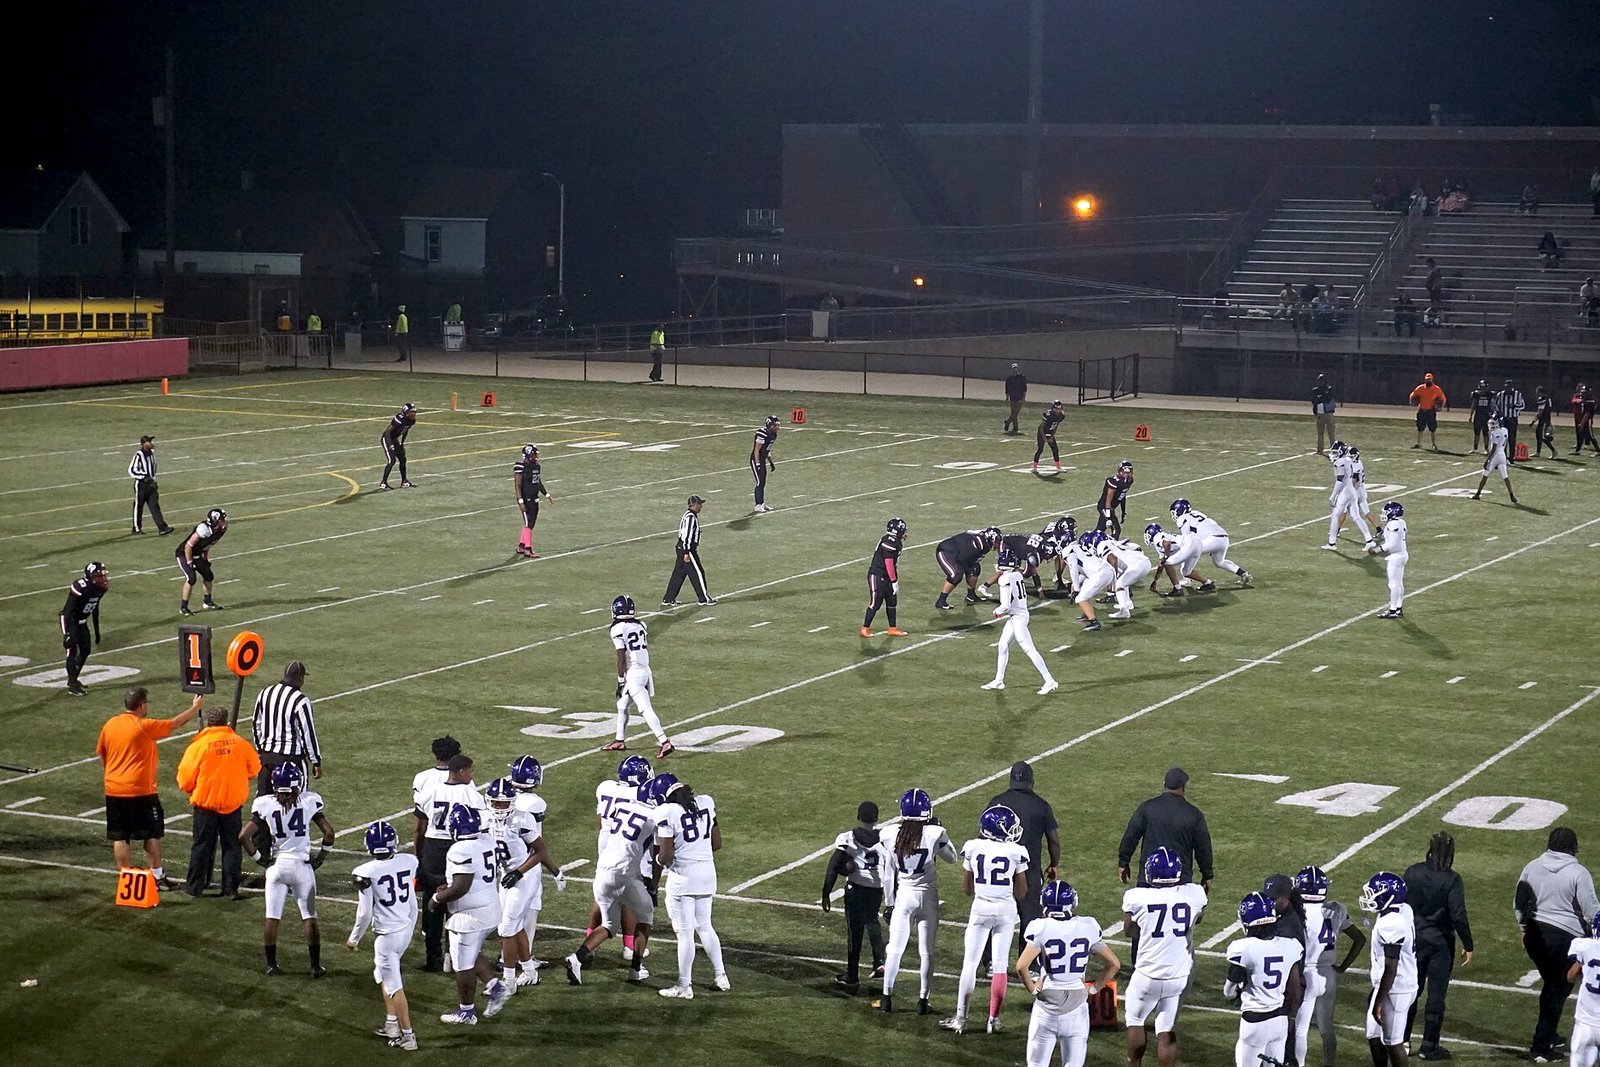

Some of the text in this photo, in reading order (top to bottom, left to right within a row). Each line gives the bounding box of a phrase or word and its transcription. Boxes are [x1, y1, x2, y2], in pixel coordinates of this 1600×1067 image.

[483, 393, 493, 406] G
[793, 410, 803, 421] 10
[1135, 426, 1148, 439] 20
[188, 634, 201, 668] 1
[271, 808, 307, 839] 14
[610, 807, 649, 842] 55
[679, 807, 712, 843] 87
[975, 853, 1011, 886] 12
[119, 872, 148, 901] 30
[377, 869, 411, 907] 35
[1147, 902, 1191, 938] 79
[1318, 918, 1336, 951] 4
[1044, 937, 1090, 974] 22
[1263, 955, 1284, 990] 5
